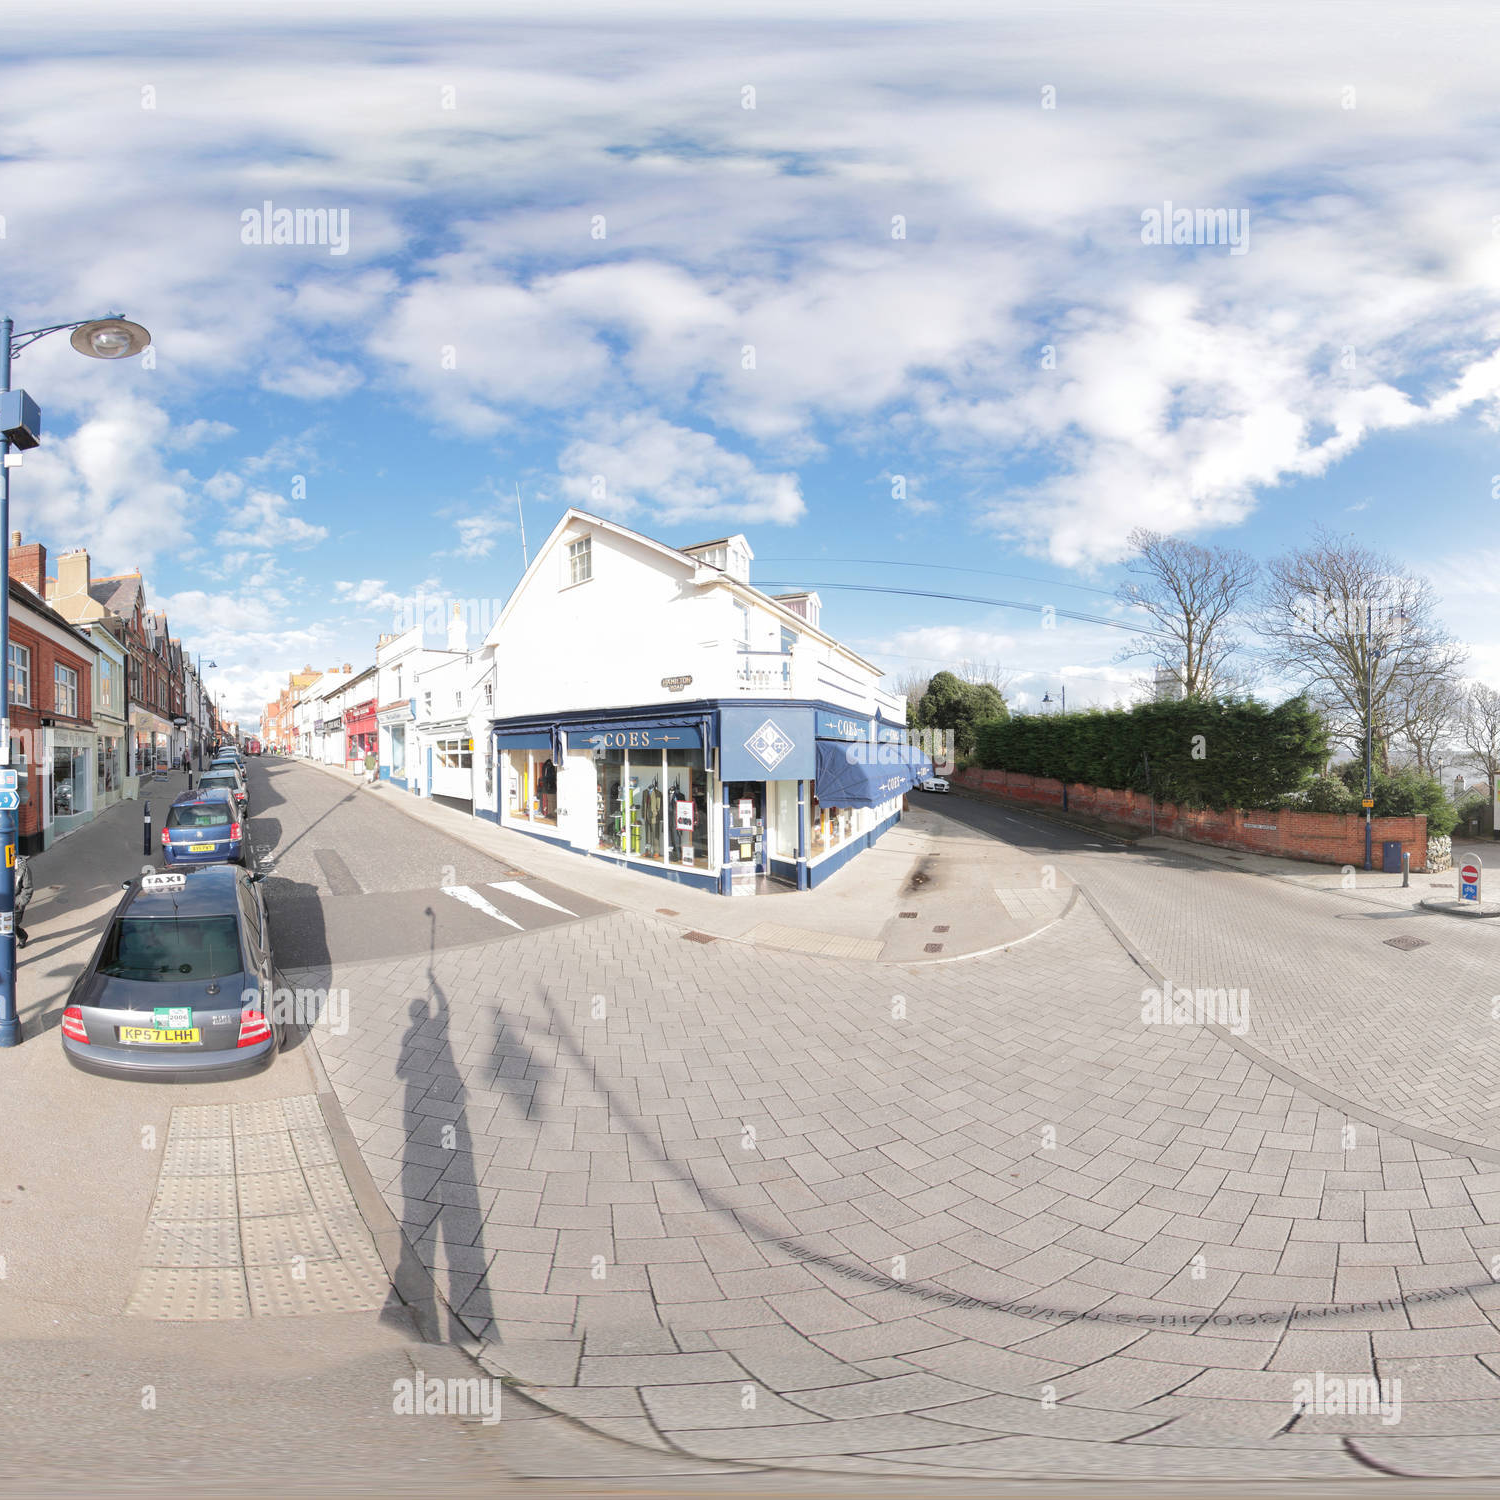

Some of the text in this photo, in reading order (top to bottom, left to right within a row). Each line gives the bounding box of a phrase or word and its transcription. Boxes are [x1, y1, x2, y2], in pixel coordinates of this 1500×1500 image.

[662, 676, 692, 687] HAMILTON
[837, 719, 858, 737] COES
[603, 732, 650, 747] COES
[887, 775, 901, 791] COES
[146, 875, 182, 884] TAXI
[125, 1029, 194, 1041] KP57 LHH
